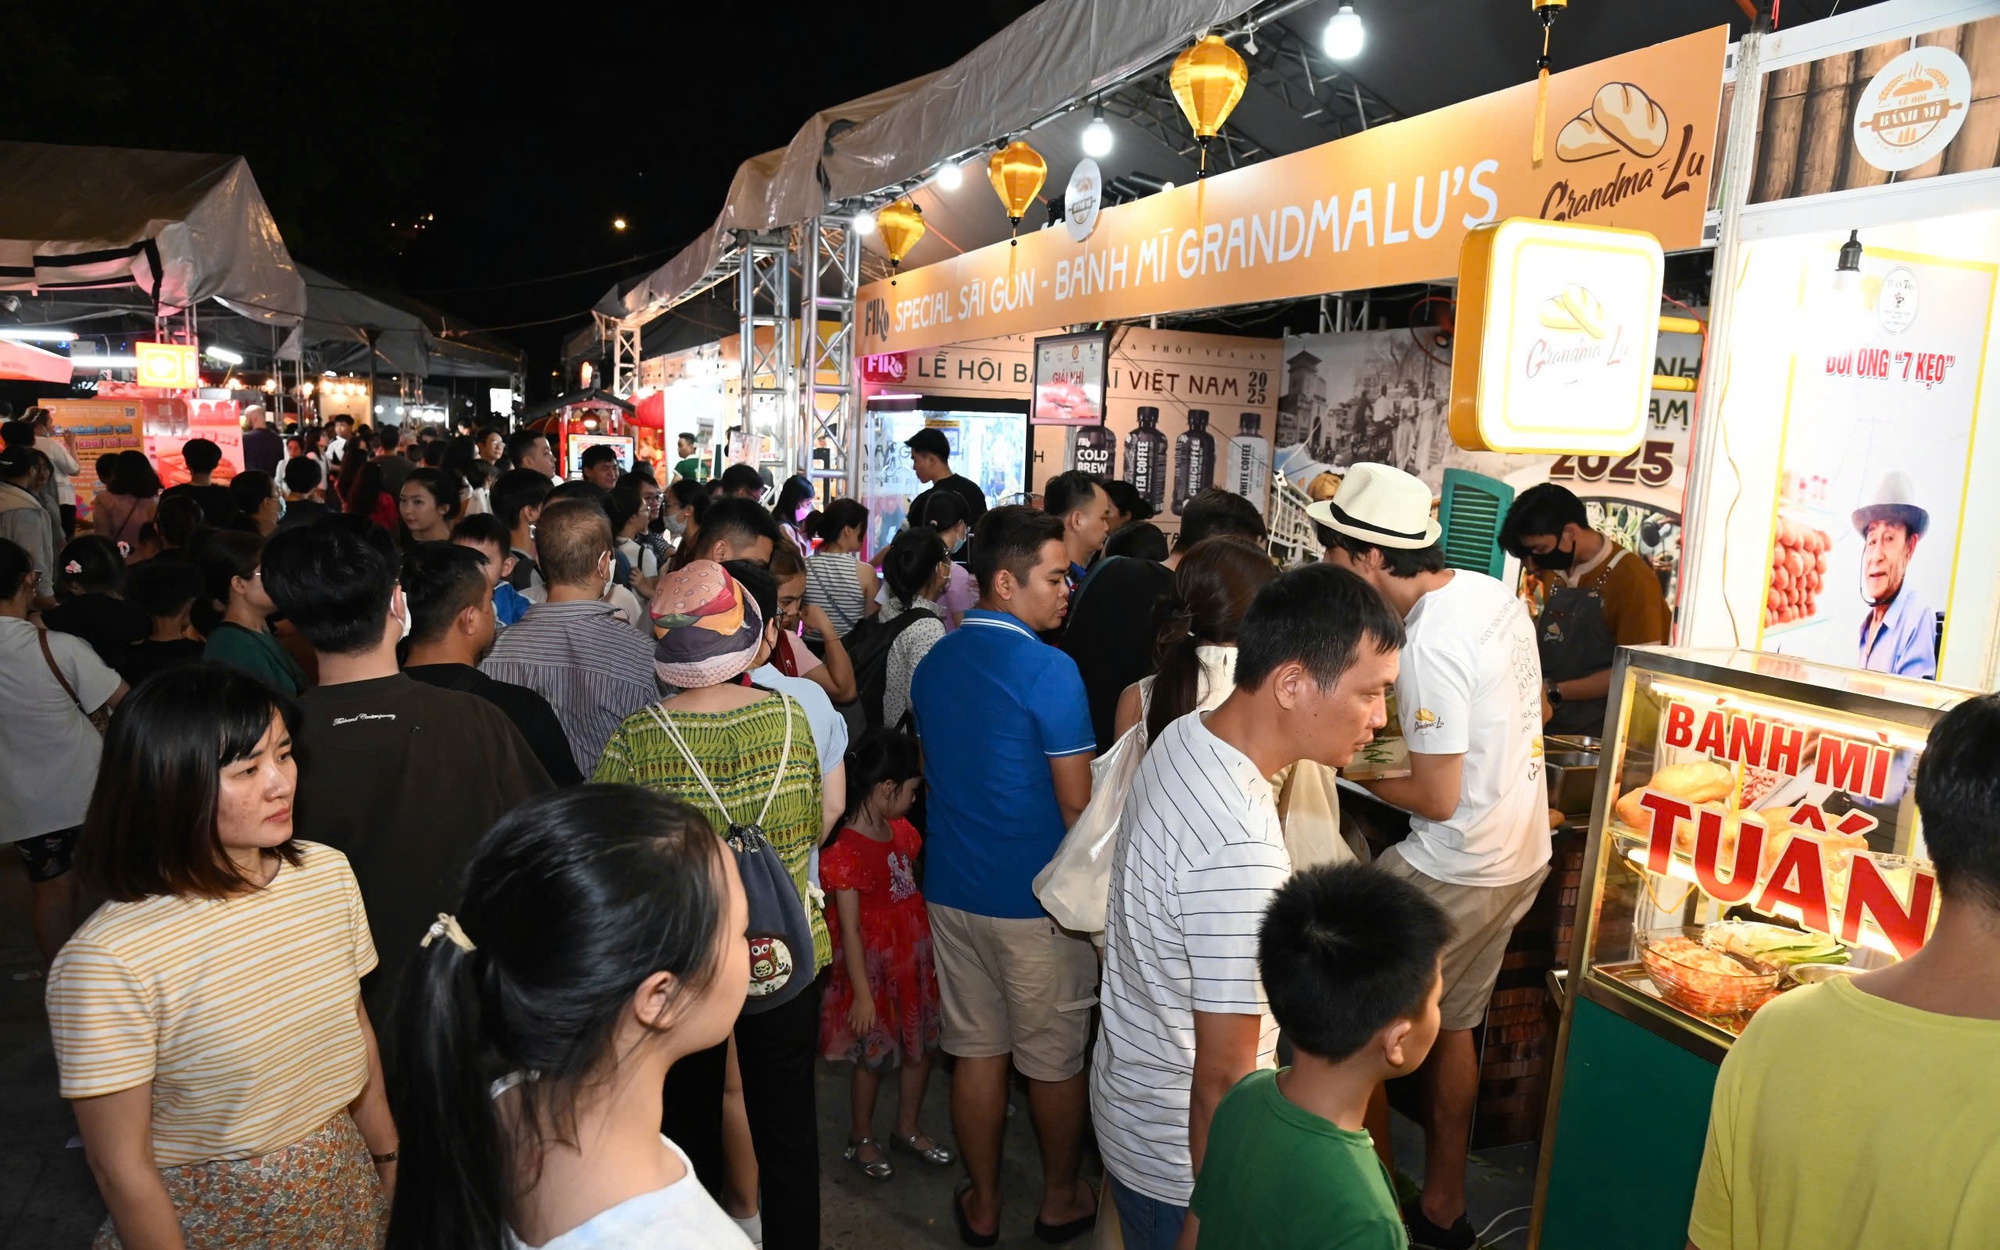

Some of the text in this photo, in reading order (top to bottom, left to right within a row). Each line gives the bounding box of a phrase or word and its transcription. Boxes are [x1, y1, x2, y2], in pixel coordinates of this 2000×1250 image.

[1879, 101, 1941, 127] BÁNH MÌ
[894, 290, 953, 333] SPECIAL
[918, 350, 949, 379] LỄ
[958, 357, 1002, 384] HỘI
[1248, 371, 1267, 388] 20
[1129, 368, 1180, 394] VIỆT
[1188, 375, 1239, 397] NAM
[1247, 388, 1266, 405] 25
[1648, 398, 1689, 427] AM
[1077, 449, 1109, 461] COLD
[1077, 462, 1107, 474] BREW
[1135, 441, 1149, 492] TEA COFFEE
[1240, 443, 1251, 496] WHITE COFFEE
[1664, 698, 1894, 800] BÁNH MÌ
[1639, 791, 1936, 962] TUẤN
